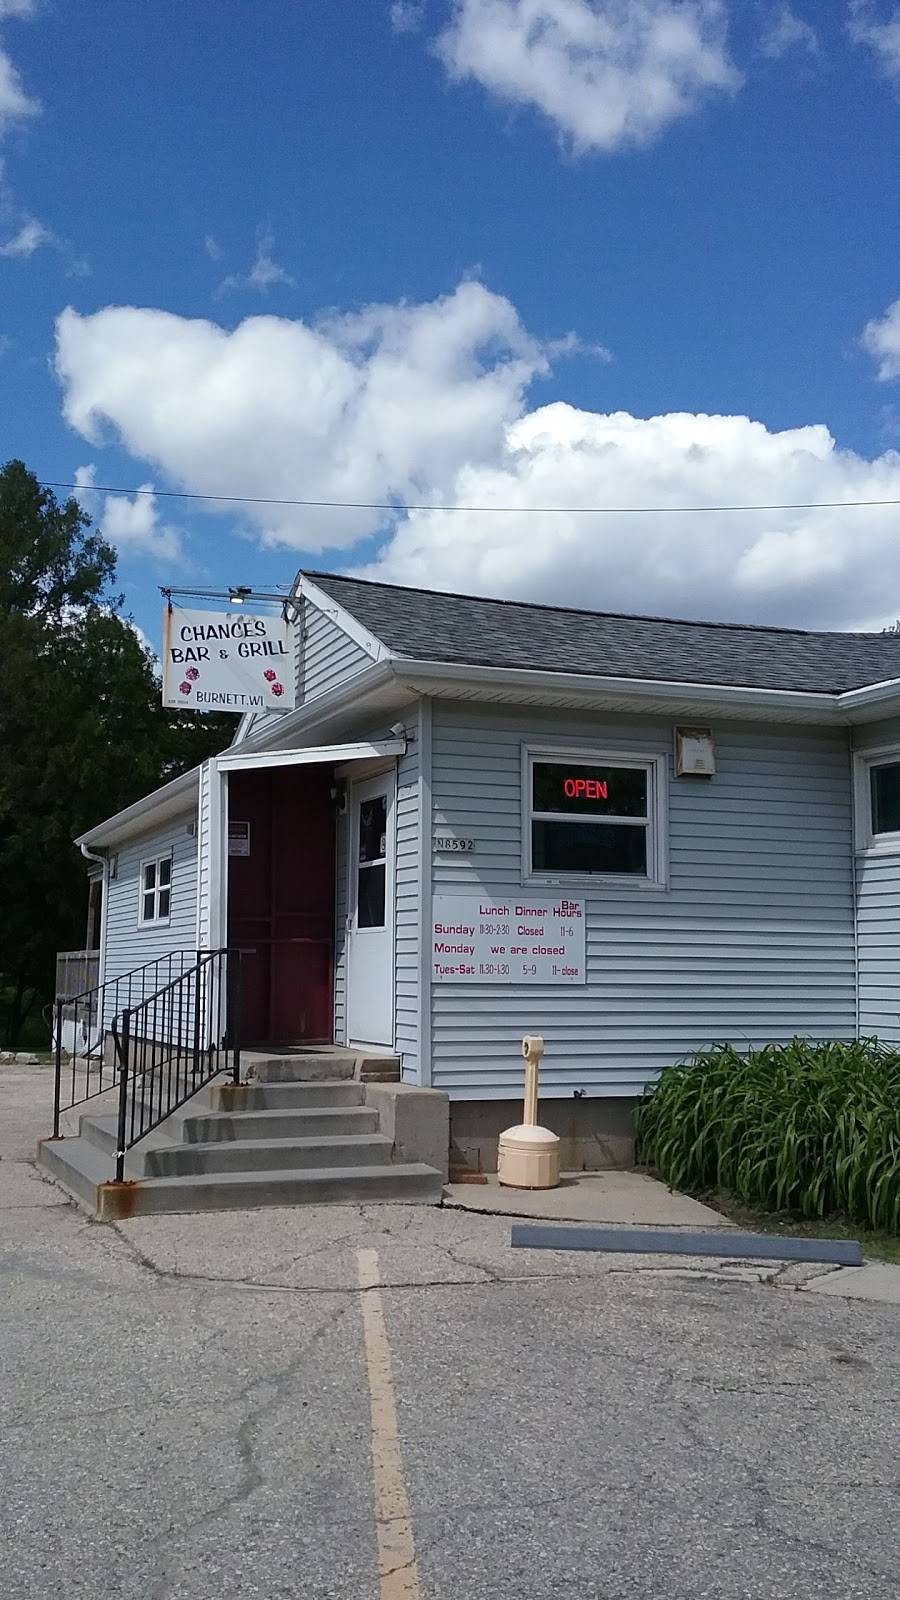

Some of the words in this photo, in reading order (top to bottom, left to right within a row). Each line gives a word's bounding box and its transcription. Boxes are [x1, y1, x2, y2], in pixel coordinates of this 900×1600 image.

[180, 620, 267, 642] CHANCES
[170, 646, 210, 663] BAR
[219, 649, 229, 660] &
[238, 640, 290, 658] GRILL
[564, 779, 608, 799] OPEN
[437, 839, 473, 850] N8592
[479, 905, 510, 916] Lunch
[515, 906, 548, 917] Dinner
[553, 907, 582, 918] Hours
[561, 900, 580, 911] Bar
[434, 923, 475, 938] Sunday
[517, 925, 544, 936] Closed
[560, 926, 574, 937] 11-6
[434, 943, 475, 956] Monday
[490, 946, 506, 955] we
[510, 946, 528, 955] are
[532, 944, 565, 955] closed
[433, 963, 475, 975] Tues-Sat
[522, 964, 537, 975] 5-9
